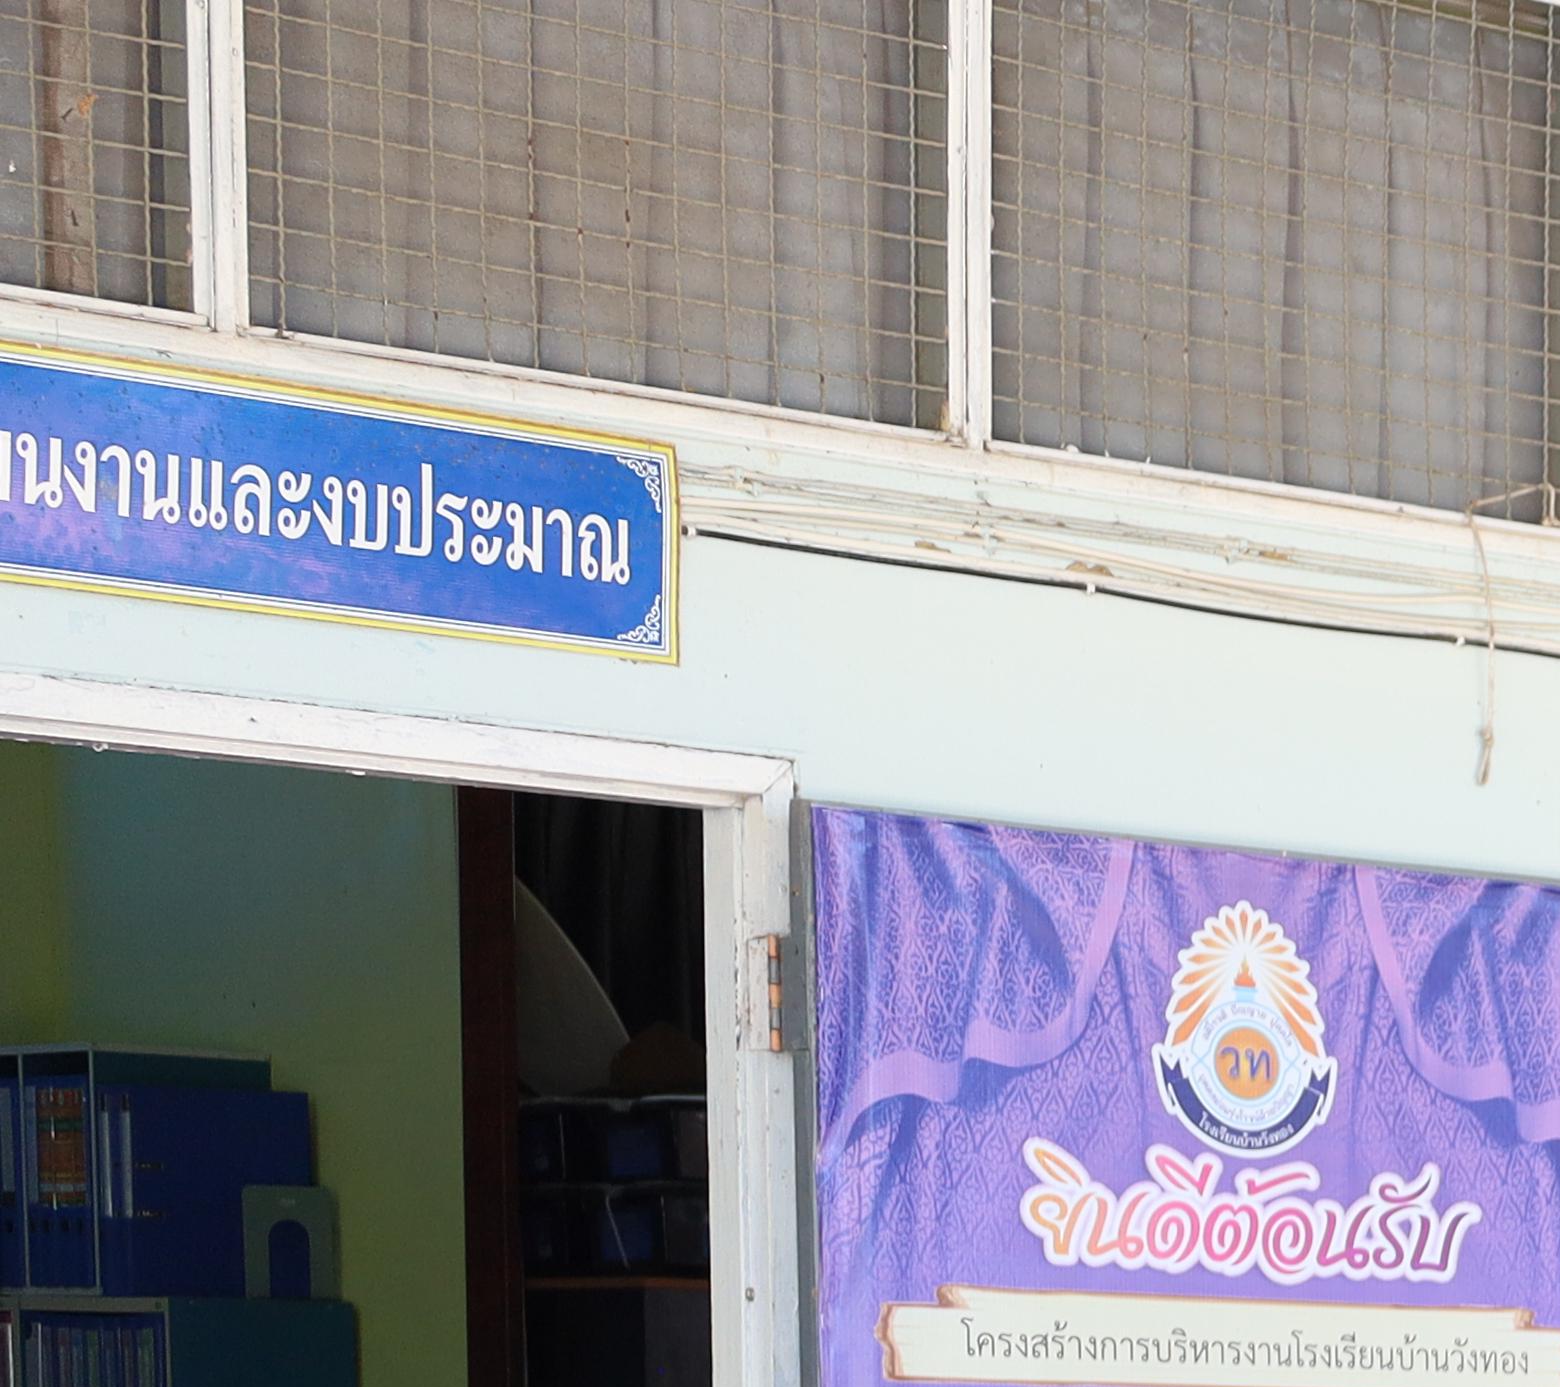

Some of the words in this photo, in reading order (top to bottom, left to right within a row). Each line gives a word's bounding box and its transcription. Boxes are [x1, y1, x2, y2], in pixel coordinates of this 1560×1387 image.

[1025, 1140, 1478, 1281] ยินดีต้อนรับ
[961, 1318, 1530, 1378] โครงสร้างการบริหารงานโรงเรียนบ้านวังทอง
